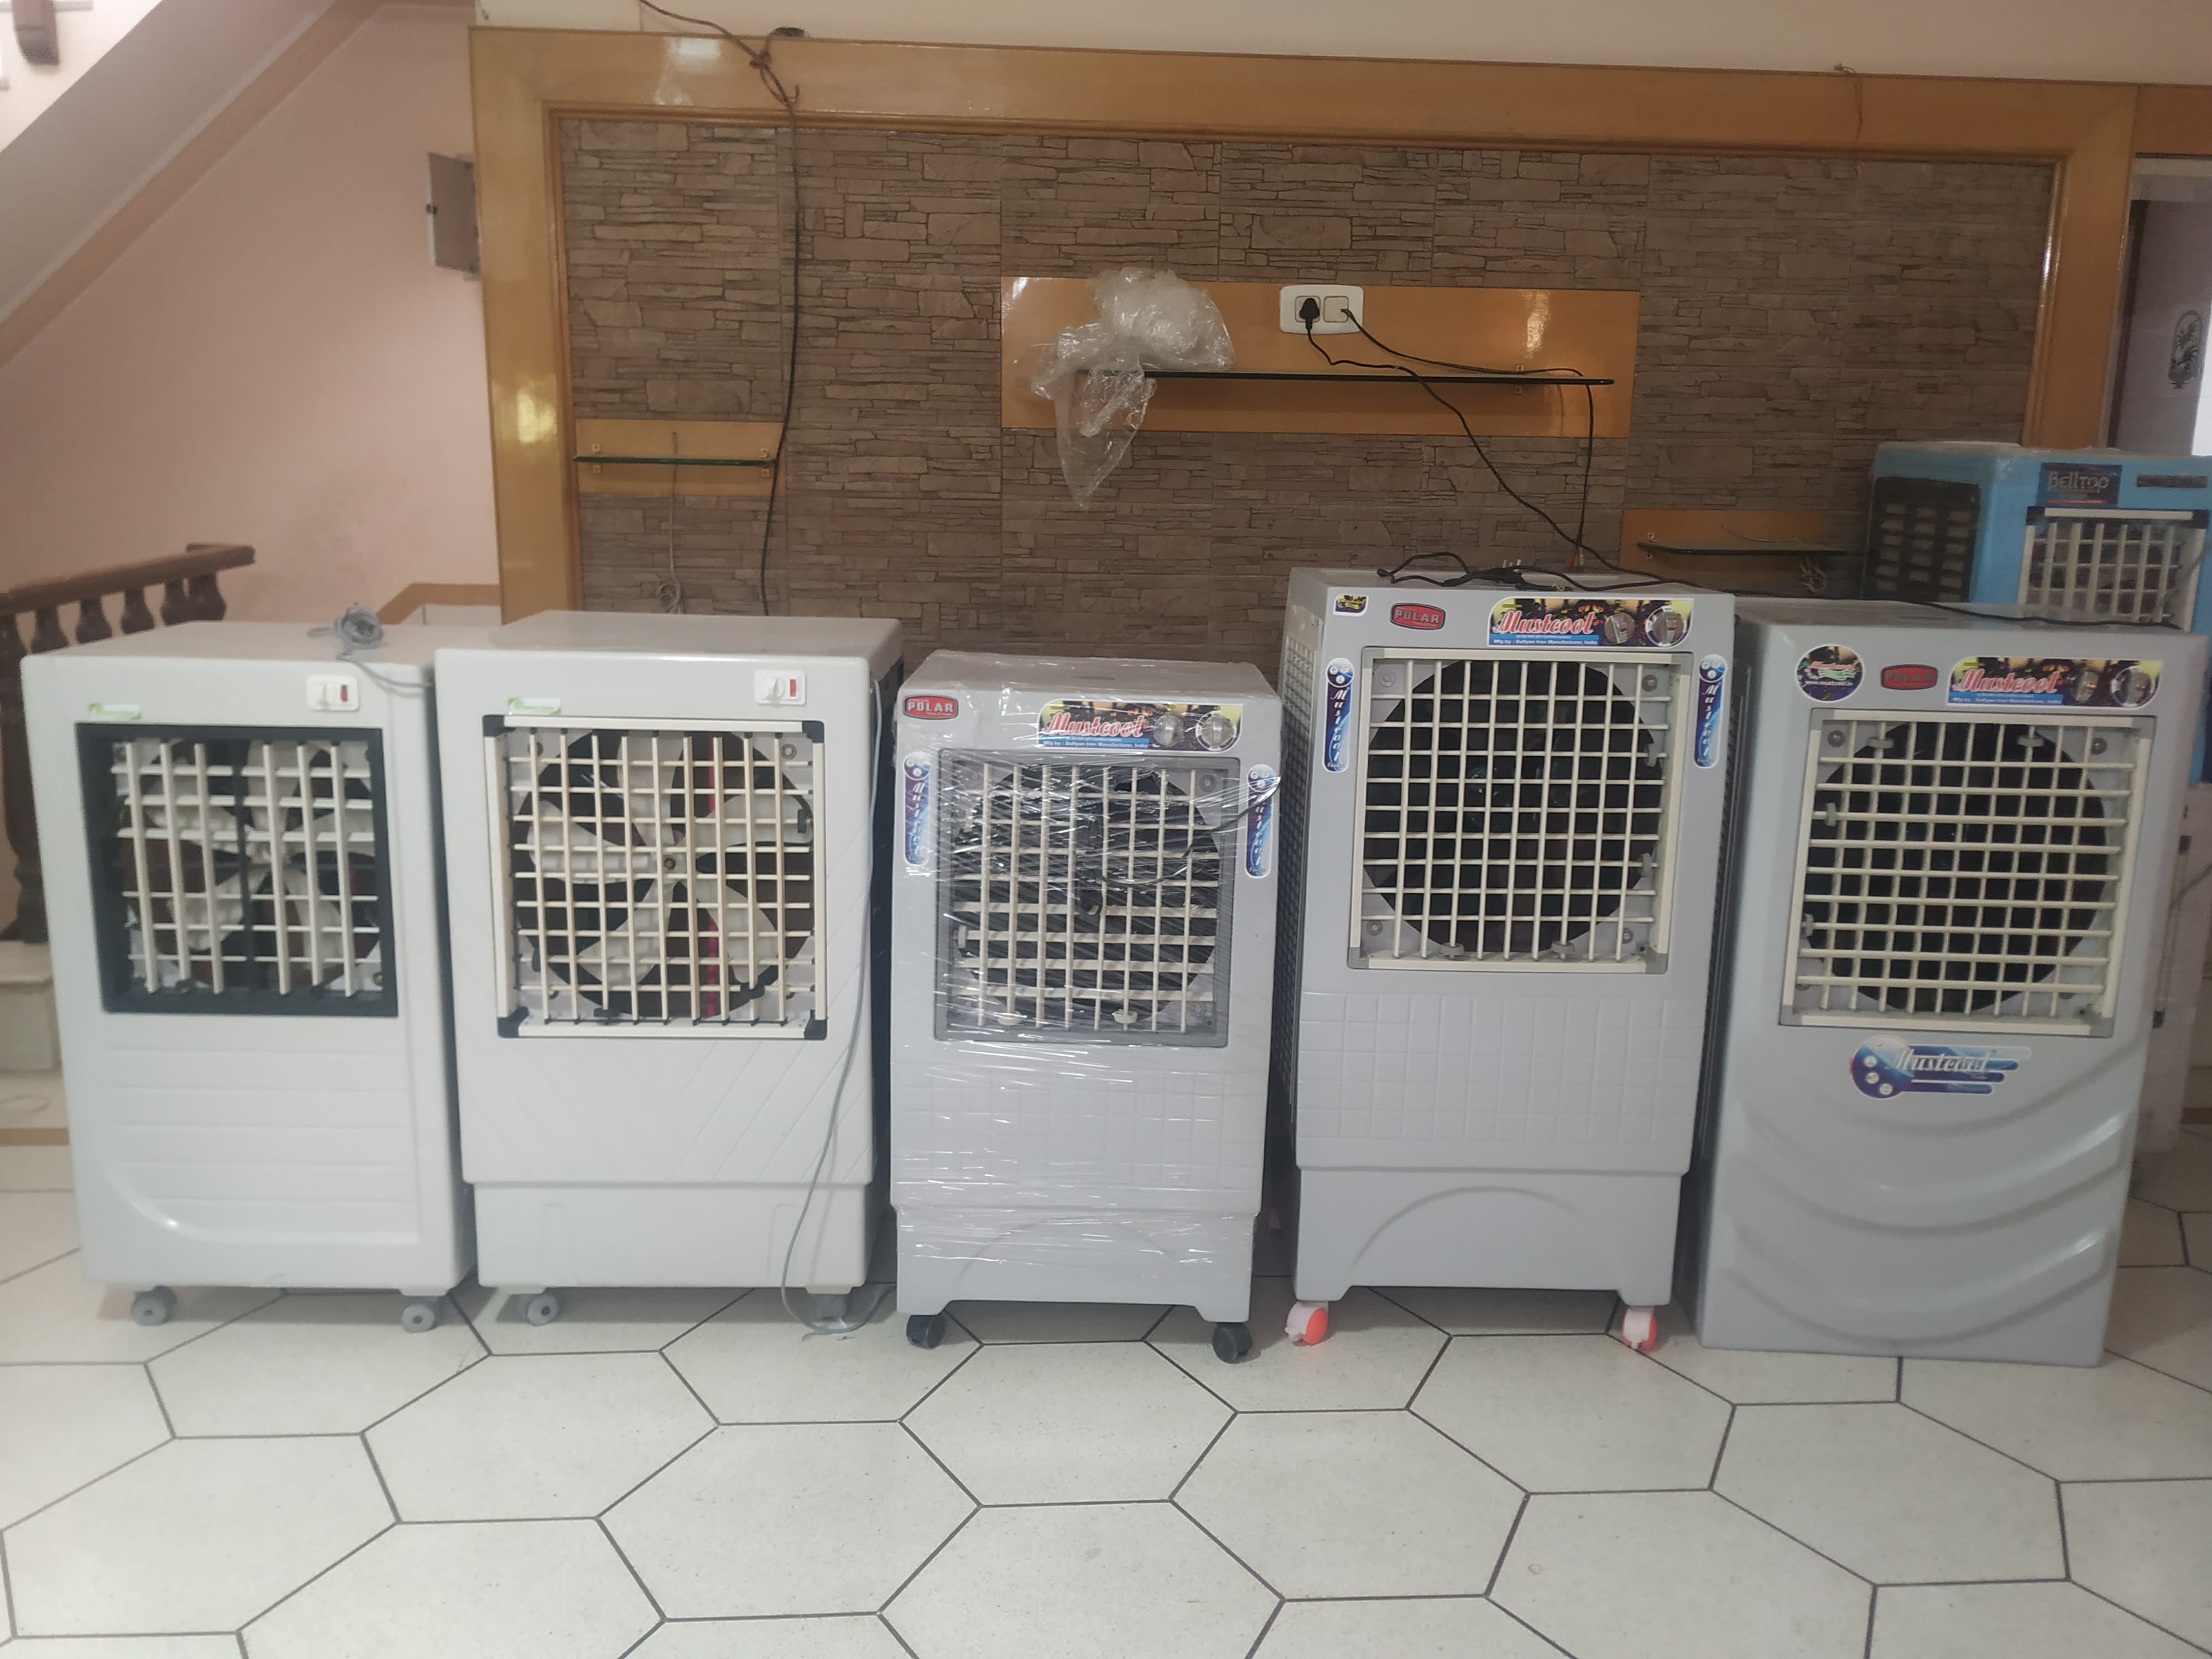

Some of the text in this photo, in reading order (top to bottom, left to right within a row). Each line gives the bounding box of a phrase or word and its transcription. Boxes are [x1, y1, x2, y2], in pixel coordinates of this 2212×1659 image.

[1395, 609, 1439, 624] POLAR
[1492, 610, 1595, 634] Mustcool
[1884, 672, 1932, 682] POLAR
[1952, 669, 2060, 693] Mustcool
[907, 701, 953, 713] POLAR
[1043, 712, 1145, 738] Mustcool
[1329, 689, 1348, 762] Mustcool
[1885, 1048, 1991, 1072] Mustcool
